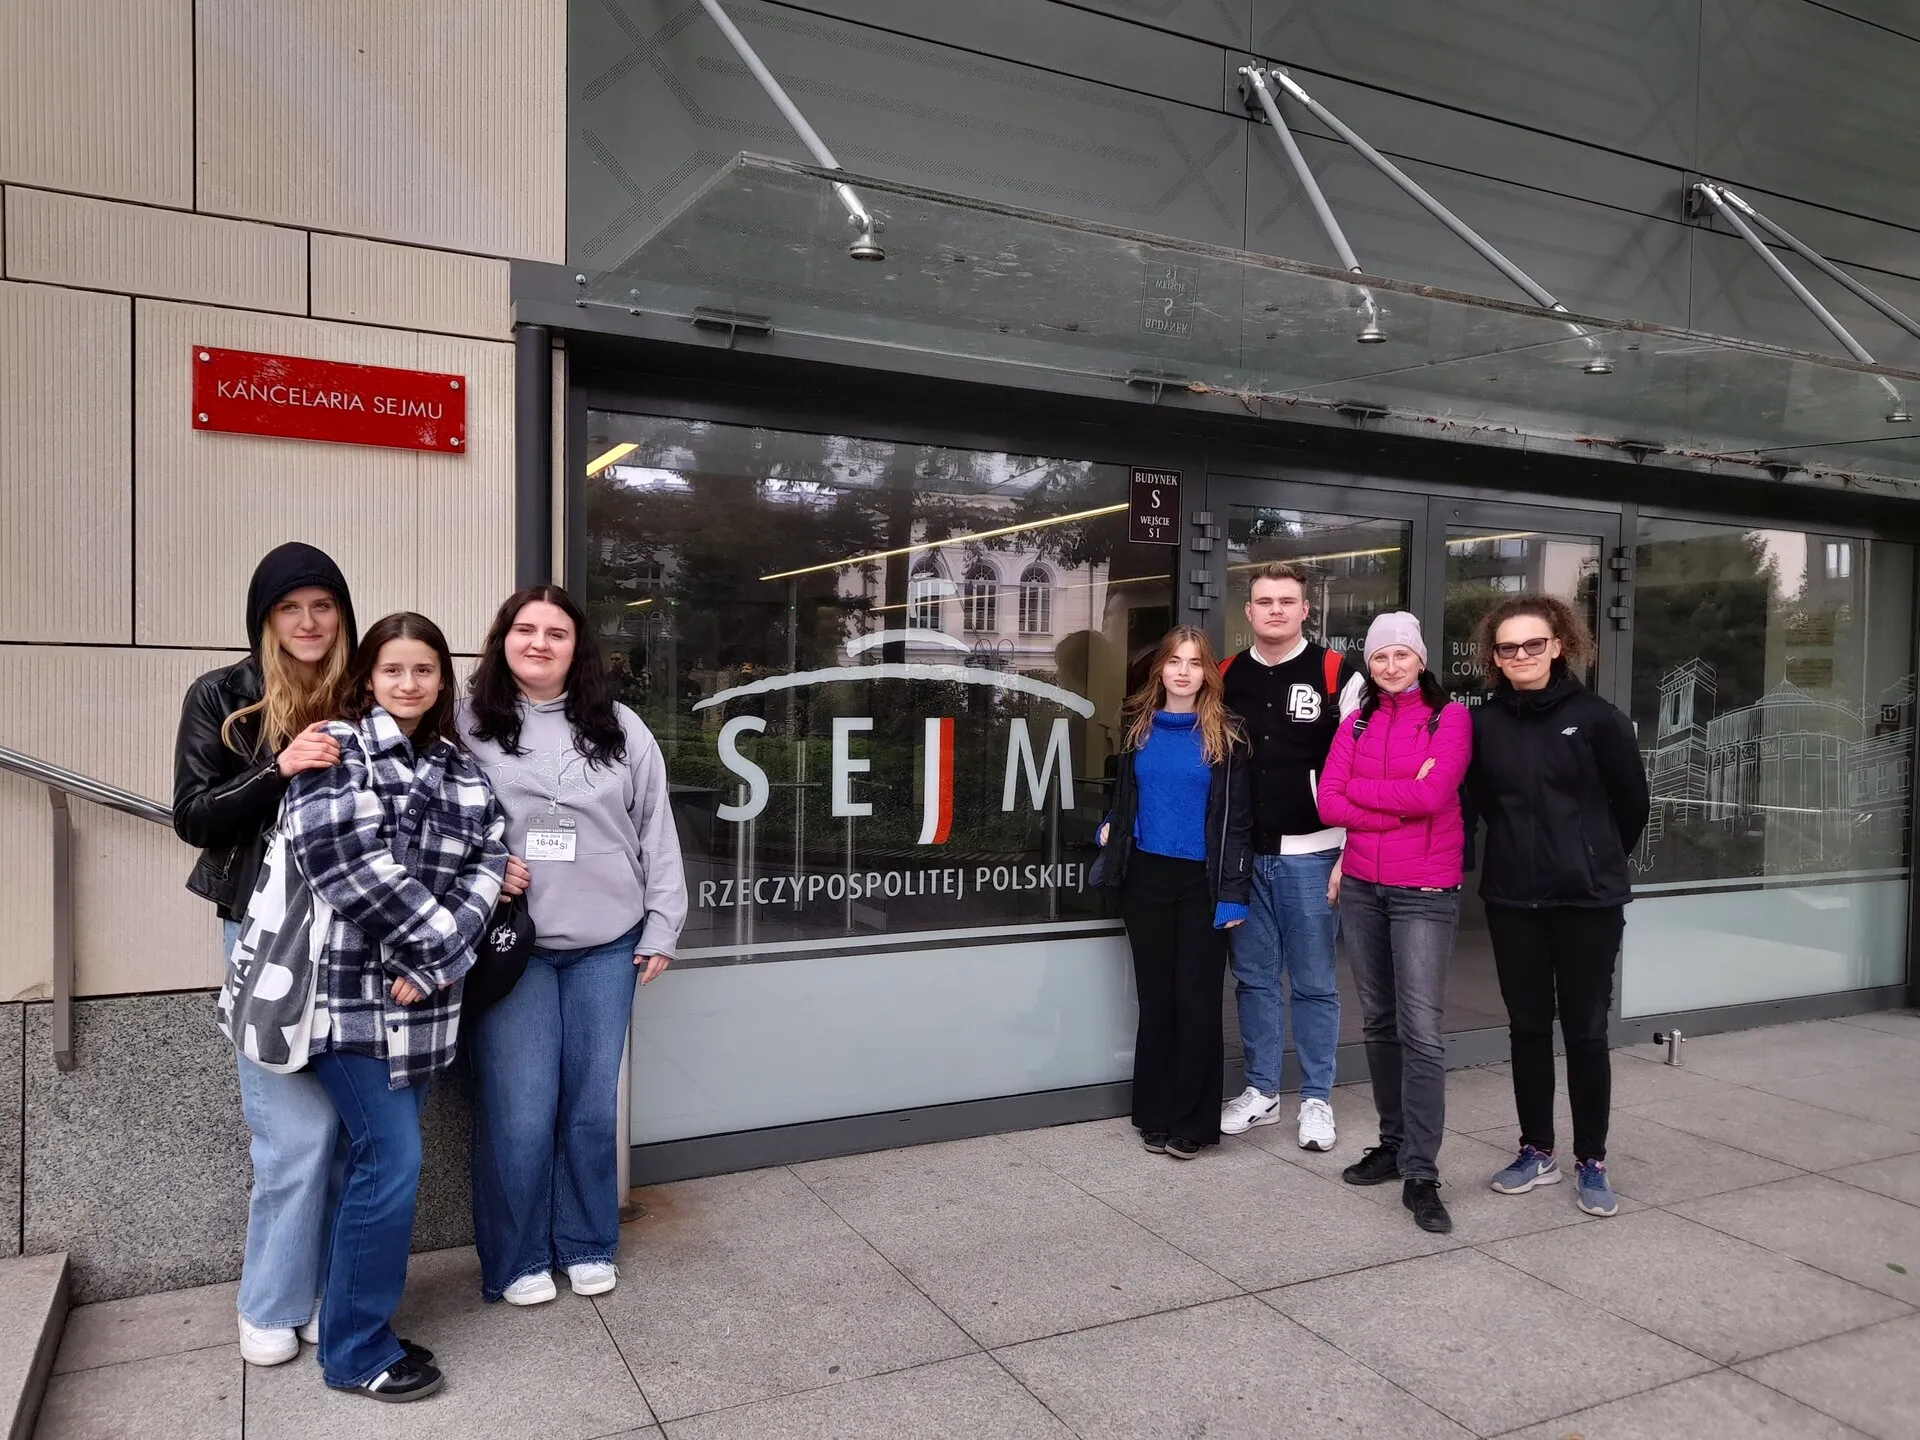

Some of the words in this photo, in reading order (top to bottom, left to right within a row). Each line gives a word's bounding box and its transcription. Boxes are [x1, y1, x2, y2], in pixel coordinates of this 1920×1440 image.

[217, 380, 365, 412] KANCELARIA
[373, 396, 443, 419] SEJMU
[1135, 472, 1178, 486] BUDYNEK
[1151, 489, 1161, 509] S
[1140, 515, 1170, 526] WEJŚCIE
[1560, 726, 1578, 736] 4F
[716, 715, 1075, 845] SEJM
[536, 838, 559, 847] 16-04
[699, 868, 965, 908] RZECZYPOSPOLITEJ
[975, 862, 1085, 895] POLSKIEJ
